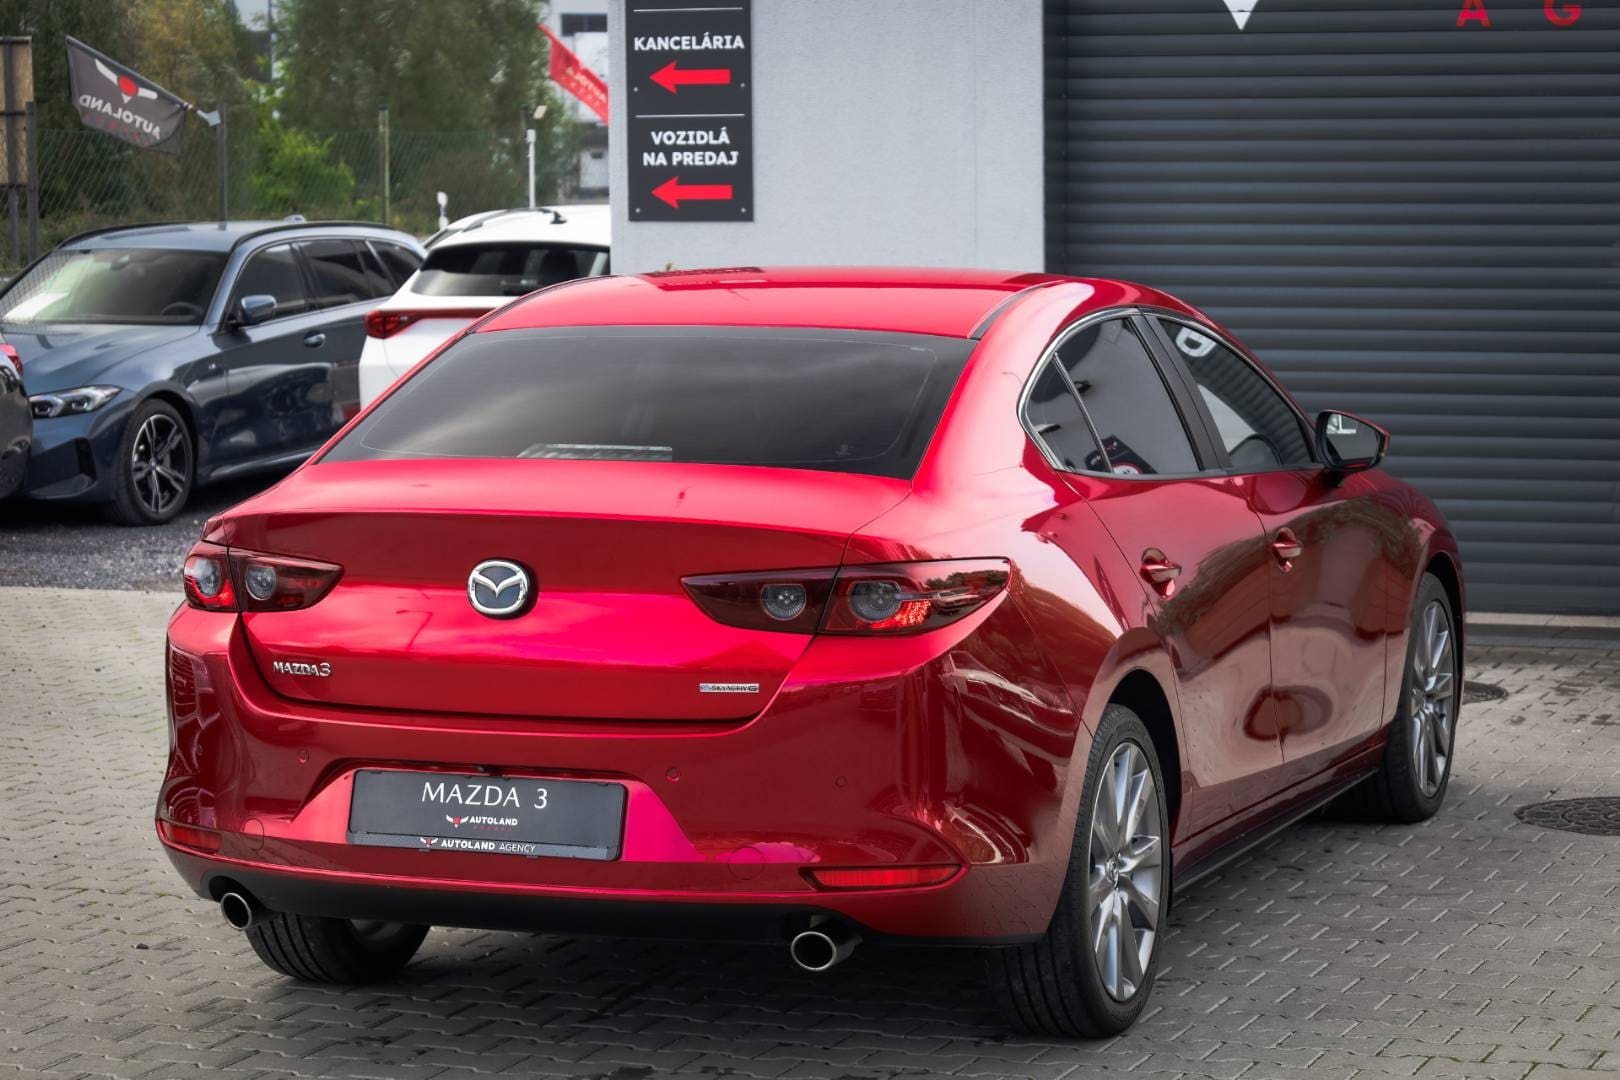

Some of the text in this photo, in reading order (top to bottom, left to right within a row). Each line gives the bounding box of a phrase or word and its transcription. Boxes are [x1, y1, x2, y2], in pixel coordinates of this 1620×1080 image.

[634, 32, 745, 51] KANCELÁRIA
[651, 126, 731, 145] VOZIDLÁ
[643, 151, 739, 166] NA PREDAJ
[421, 781, 548, 809] MAZDA 3
[469, 816, 518, 826] AUTOLAND
[441, 840, 536, 853] AUTOLAND AGENCY
